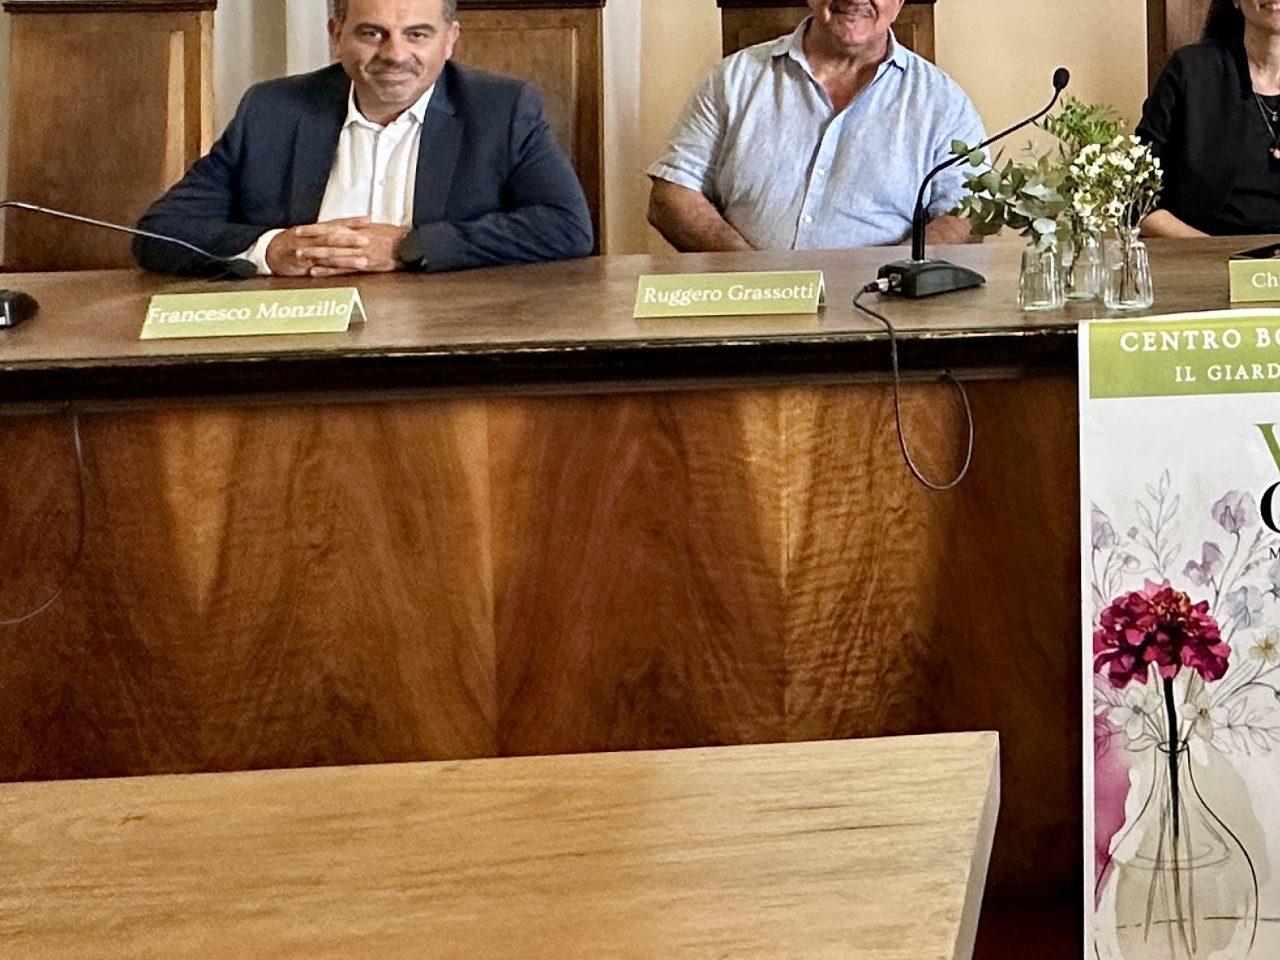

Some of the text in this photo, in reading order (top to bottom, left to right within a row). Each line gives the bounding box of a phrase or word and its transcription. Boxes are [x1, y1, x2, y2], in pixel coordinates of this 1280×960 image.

[643, 283, 815, 307] Ruggero Grassotti
[147, 300, 349, 325] Francesco Monzillo
[1120, 329, 1243, 353] CENTRO
[1174, 366, 1197, 383] IL
